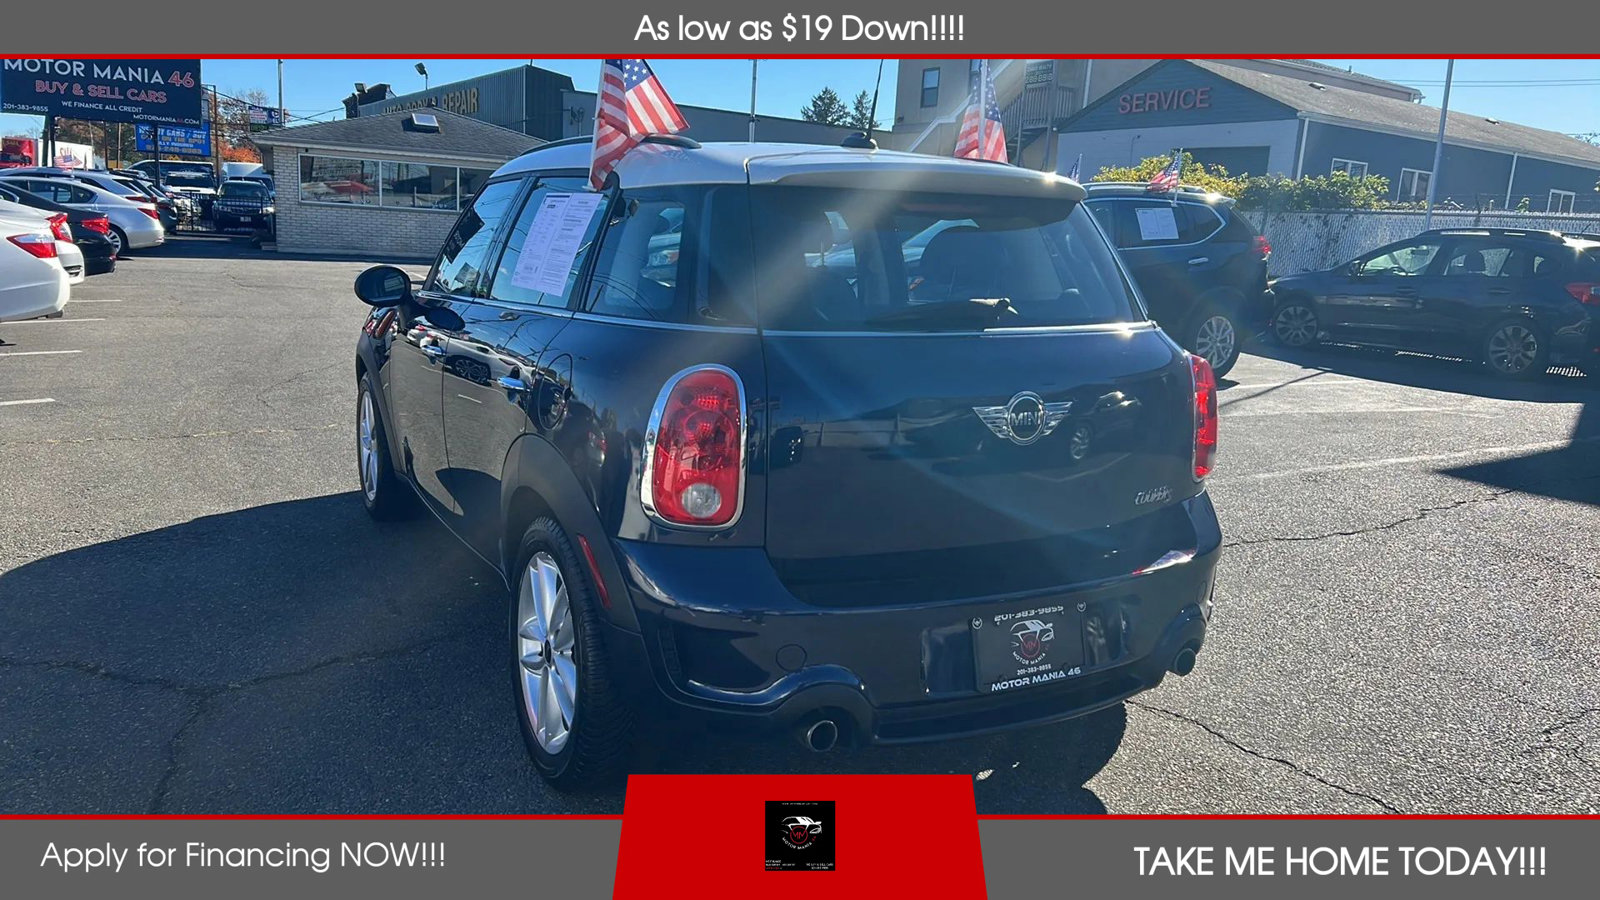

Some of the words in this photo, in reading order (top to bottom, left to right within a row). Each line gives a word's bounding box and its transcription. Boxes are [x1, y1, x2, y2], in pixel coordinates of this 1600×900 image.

[4, 59, 85, 77] MOTOR
[93, 63, 164, 85] MANIA
[168, 71, 194, 88] 46
[35, 80, 68, 94] BUY
[72, 83, 84, 96] &
[87, 84, 124, 100] SELL
[127, 88, 167, 104] CARS
[443, 88, 478, 114] REPAIR
[1118, 87, 1211, 114] SERVICE
[3, 102, 48, 112] 201-383-9855
[73, 101, 103, 110] FINANCE
[118, 105, 143, 113] CREDIT
[1011, 411, 1041, 426] MINI
[991, 677, 1030, 692] MOTOR
[1032, 670, 1066, 684] MANIA
[1067, 667, 1081, 676] 46
